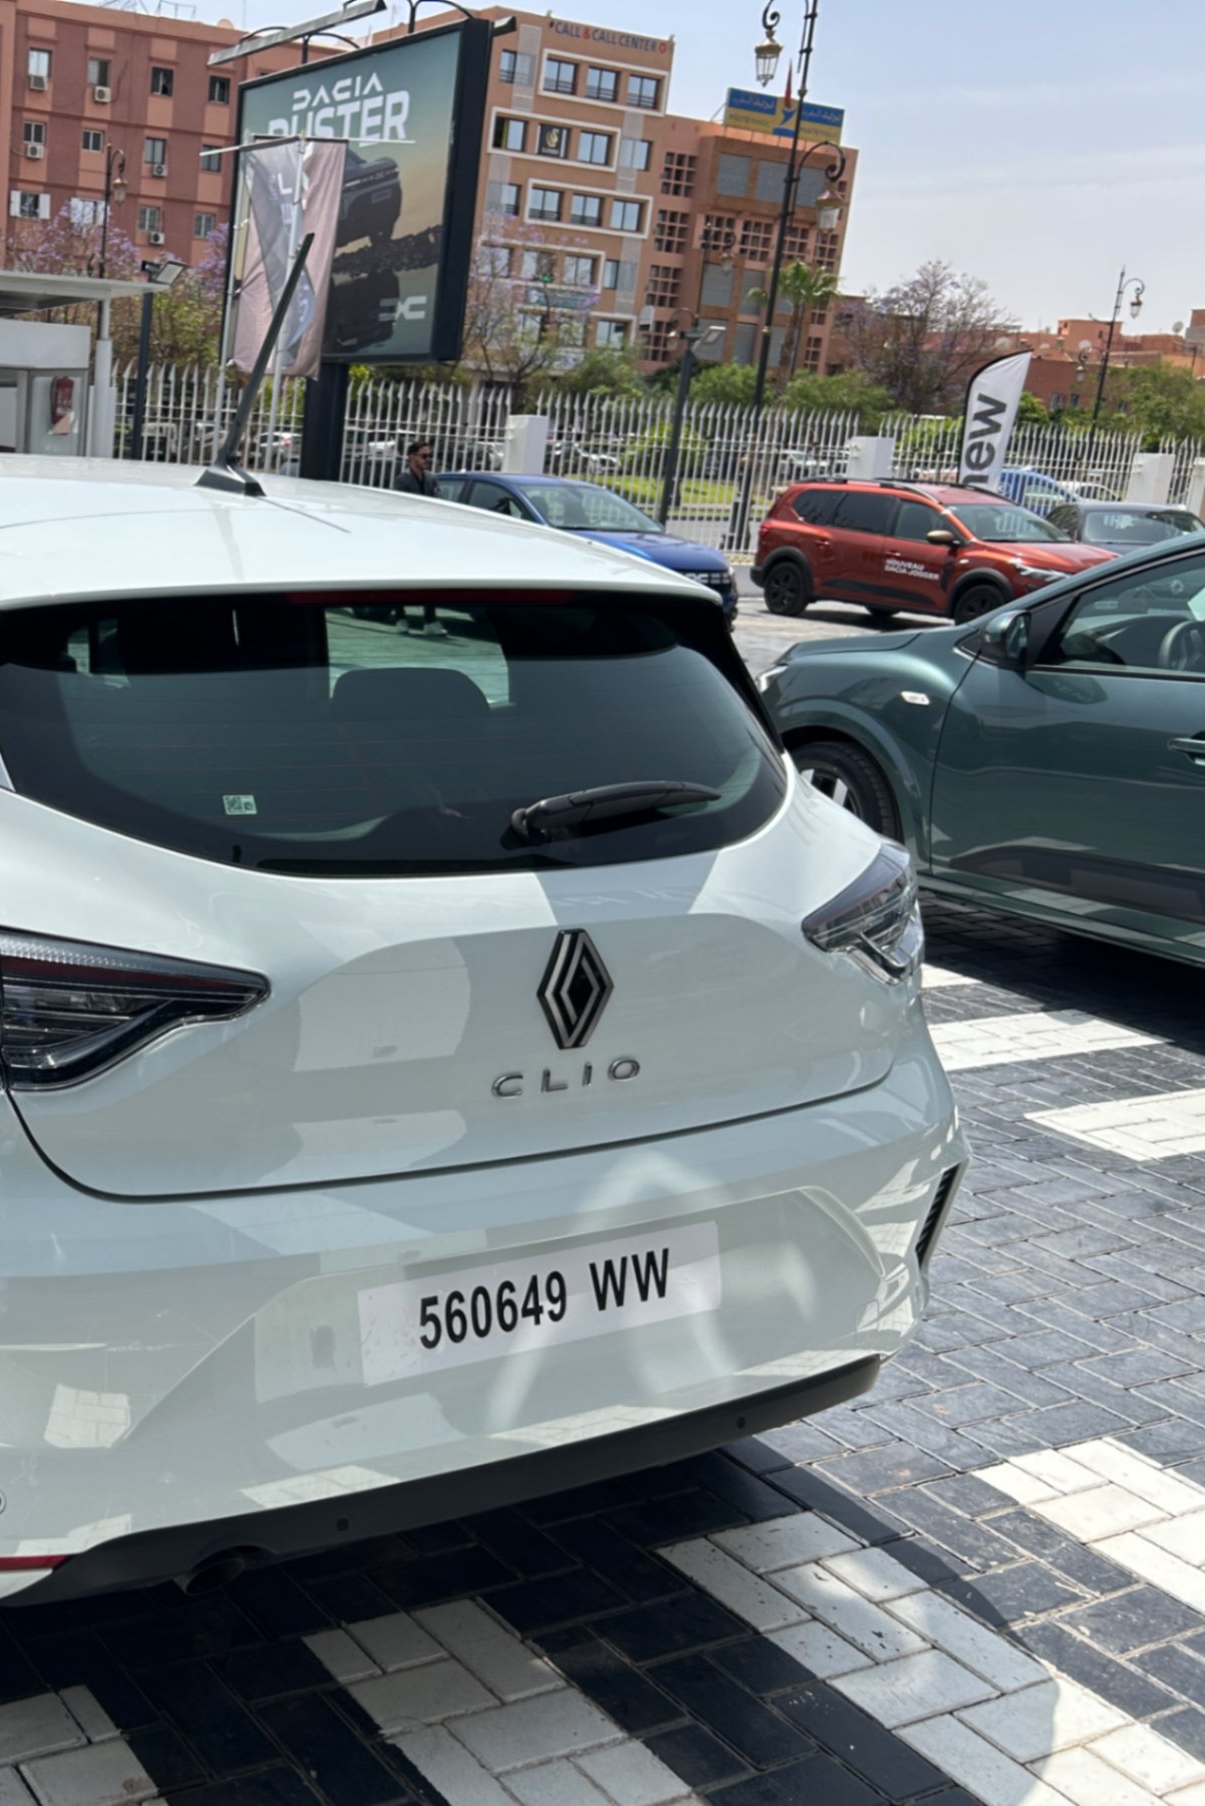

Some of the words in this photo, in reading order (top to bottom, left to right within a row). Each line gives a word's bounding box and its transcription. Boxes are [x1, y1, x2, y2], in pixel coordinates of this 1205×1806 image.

[554, 21, 581, 38] CALL
[591, 28, 616, 45] CALL
[617, 34, 657, 53] CENTER
[292, 72, 384, 111] DACIA
[491, 1056, 641, 1099] CLIO
[419, 1270, 567, 1350] 560649
[589, 1247, 670, 1312] WW
